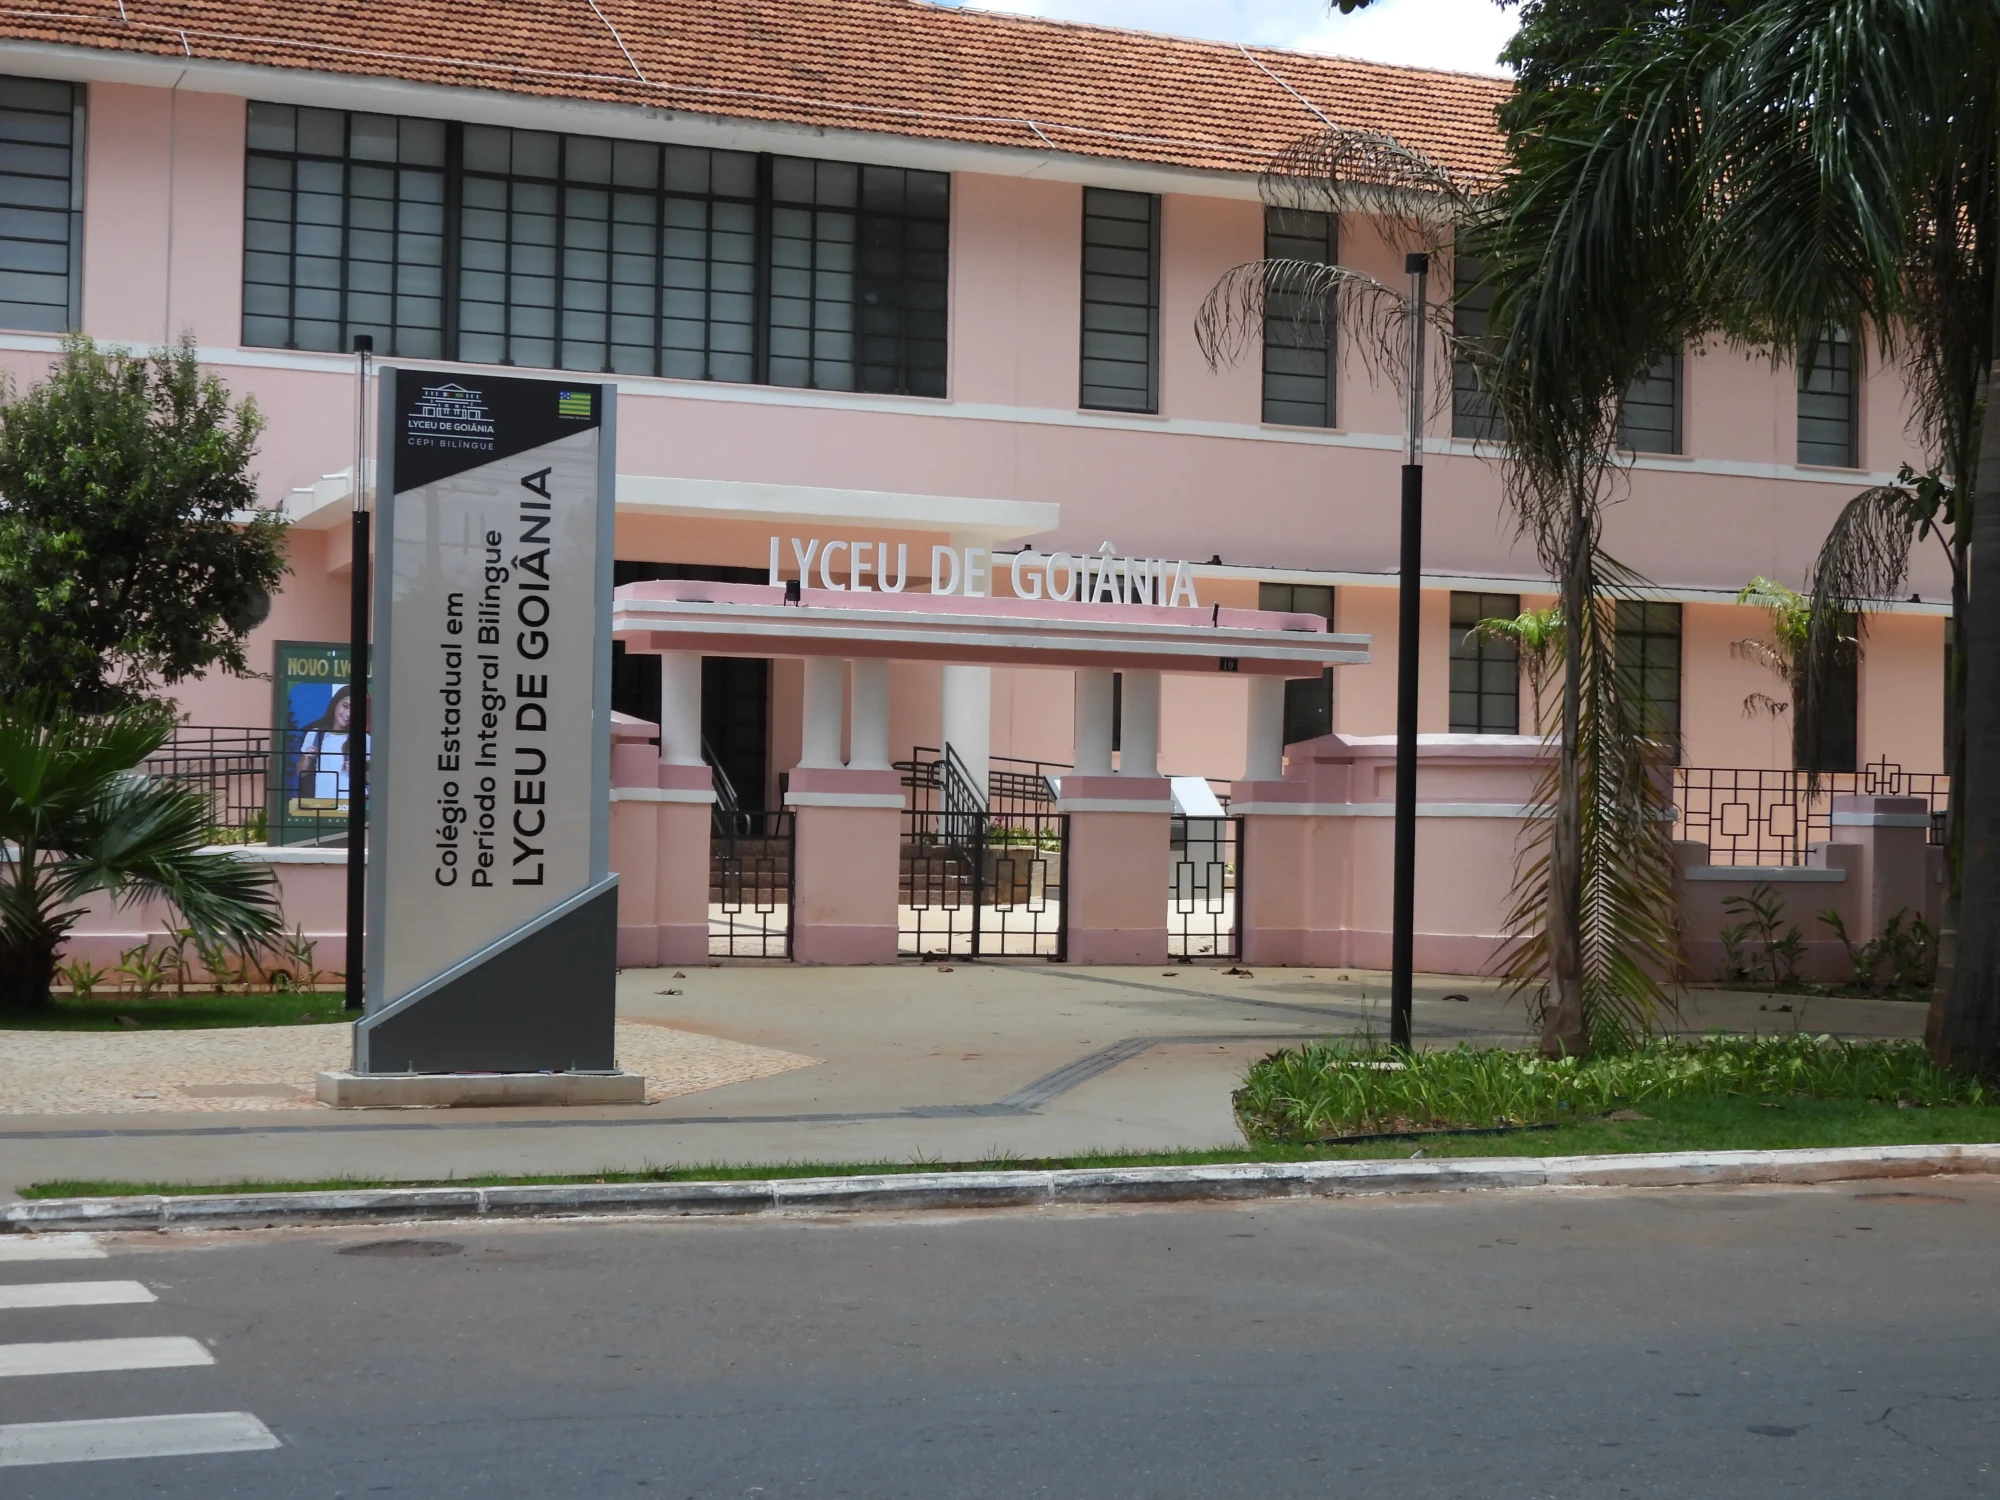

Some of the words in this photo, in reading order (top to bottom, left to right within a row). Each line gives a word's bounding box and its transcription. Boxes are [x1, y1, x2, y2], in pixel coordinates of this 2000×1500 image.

[408, 420, 437, 429] LYCEU
[440, 422, 452, 430] DE
[454, 423, 494, 433] GOIÂNIA
[408, 438, 434, 446] CEPI
[440, 440, 494, 450] BILÍNGUE
[447, 593, 464, 634] em
[478, 531, 509, 645] Bilíngue
[511, 467, 551, 660] GOIÂNIA
[769, 536, 907, 594] LYCEU
[931, 545, 986, 597] DE
[1011, 540, 1199, 608] GOIÂNIA
[287, 657, 329, 677] NOVO
[437, 644, 463, 772] Estadual
[475, 655, 506, 767] Integral
[516, 674, 547, 732] DE
[435, 782, 467, 887] Colégio
[472, 777, 496, 887] Período
[513, 748, 546, 886] LYCEU
